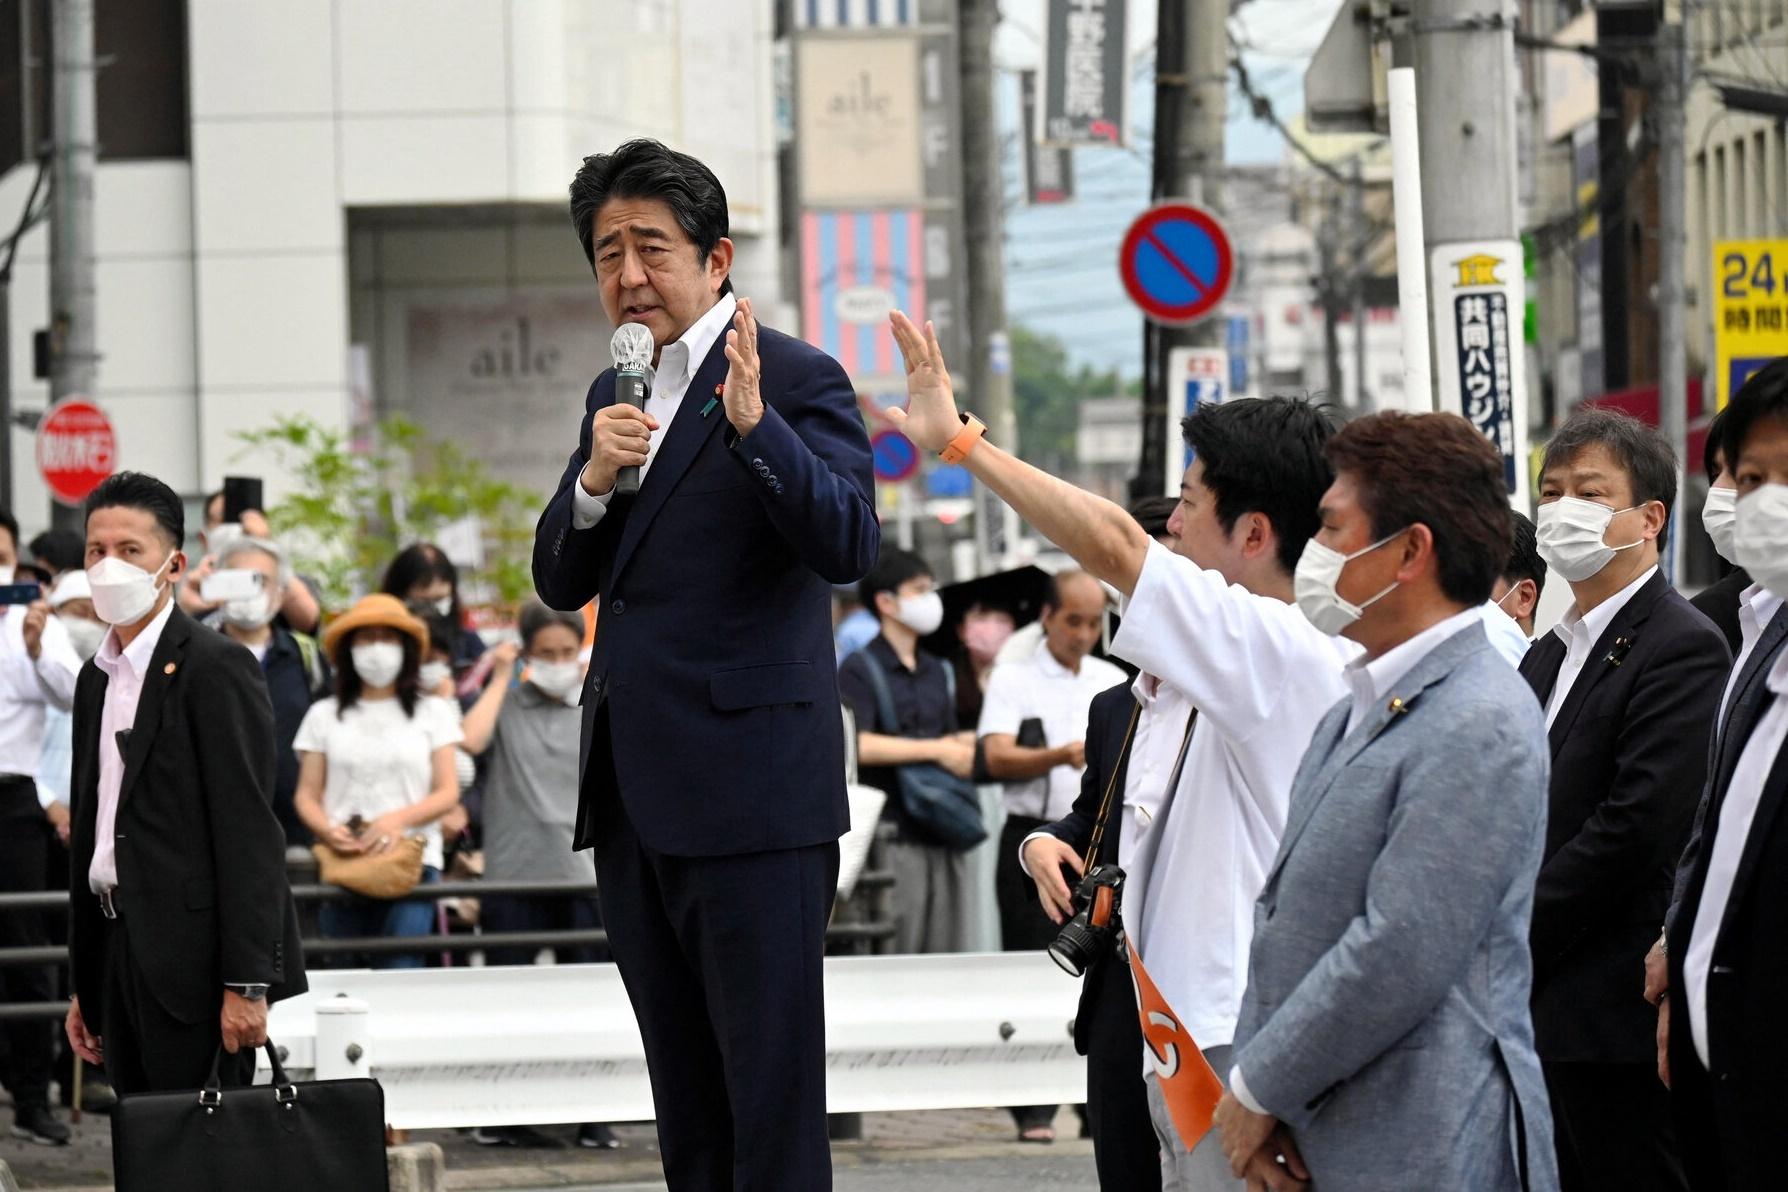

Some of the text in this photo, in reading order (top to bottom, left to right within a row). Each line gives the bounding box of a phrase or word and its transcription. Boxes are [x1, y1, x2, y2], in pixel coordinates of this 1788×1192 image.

[1723, 252, 1788, 299] 24
[1723, 304, 1788, 334] 時間
[470, 317, 561, 379] aile
[1460, 297, 1496, 446] 共同ハウジン
